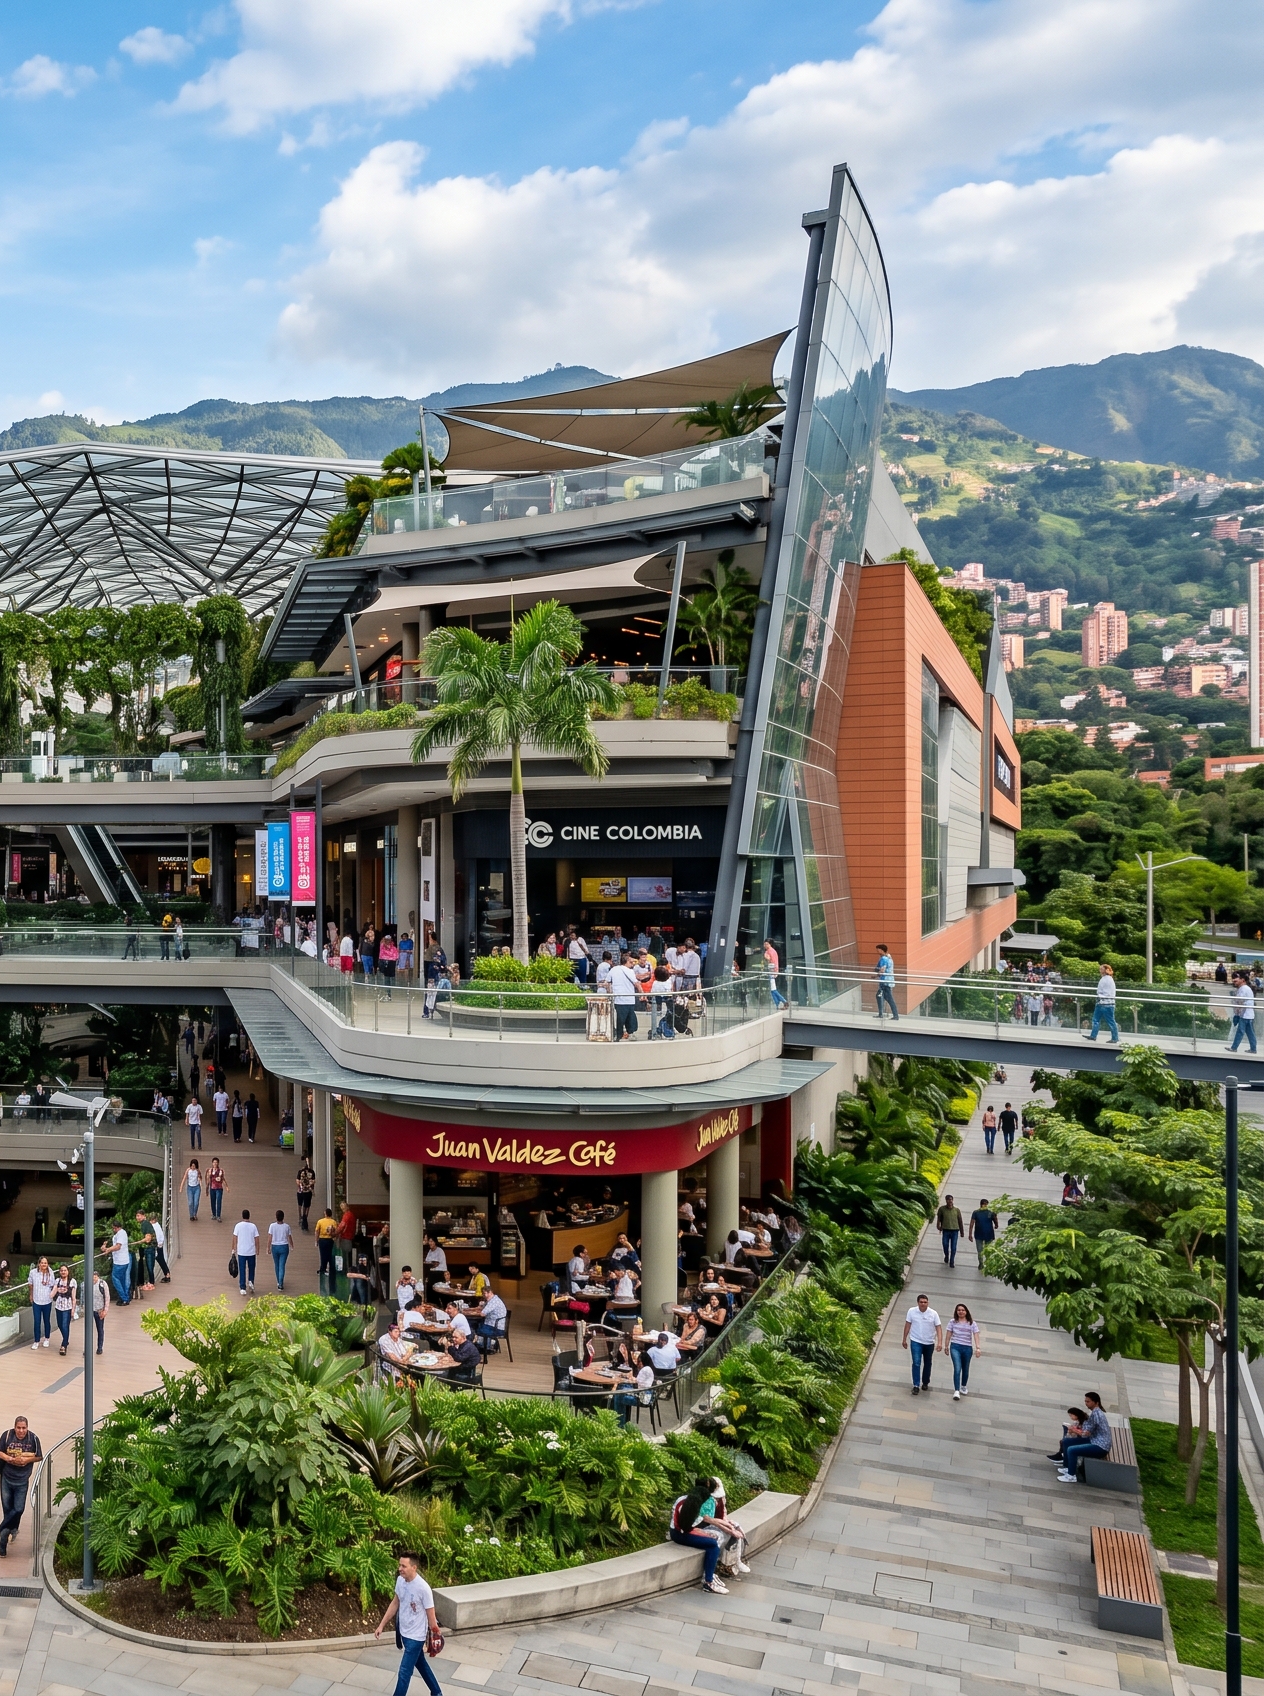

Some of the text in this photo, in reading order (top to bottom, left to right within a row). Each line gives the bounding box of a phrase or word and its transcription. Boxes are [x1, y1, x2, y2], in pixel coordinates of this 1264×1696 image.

[560, 824, 703, 841] CINE COLOMBIA
[426, 1131, 617, 1168] Juan Valdez Café
